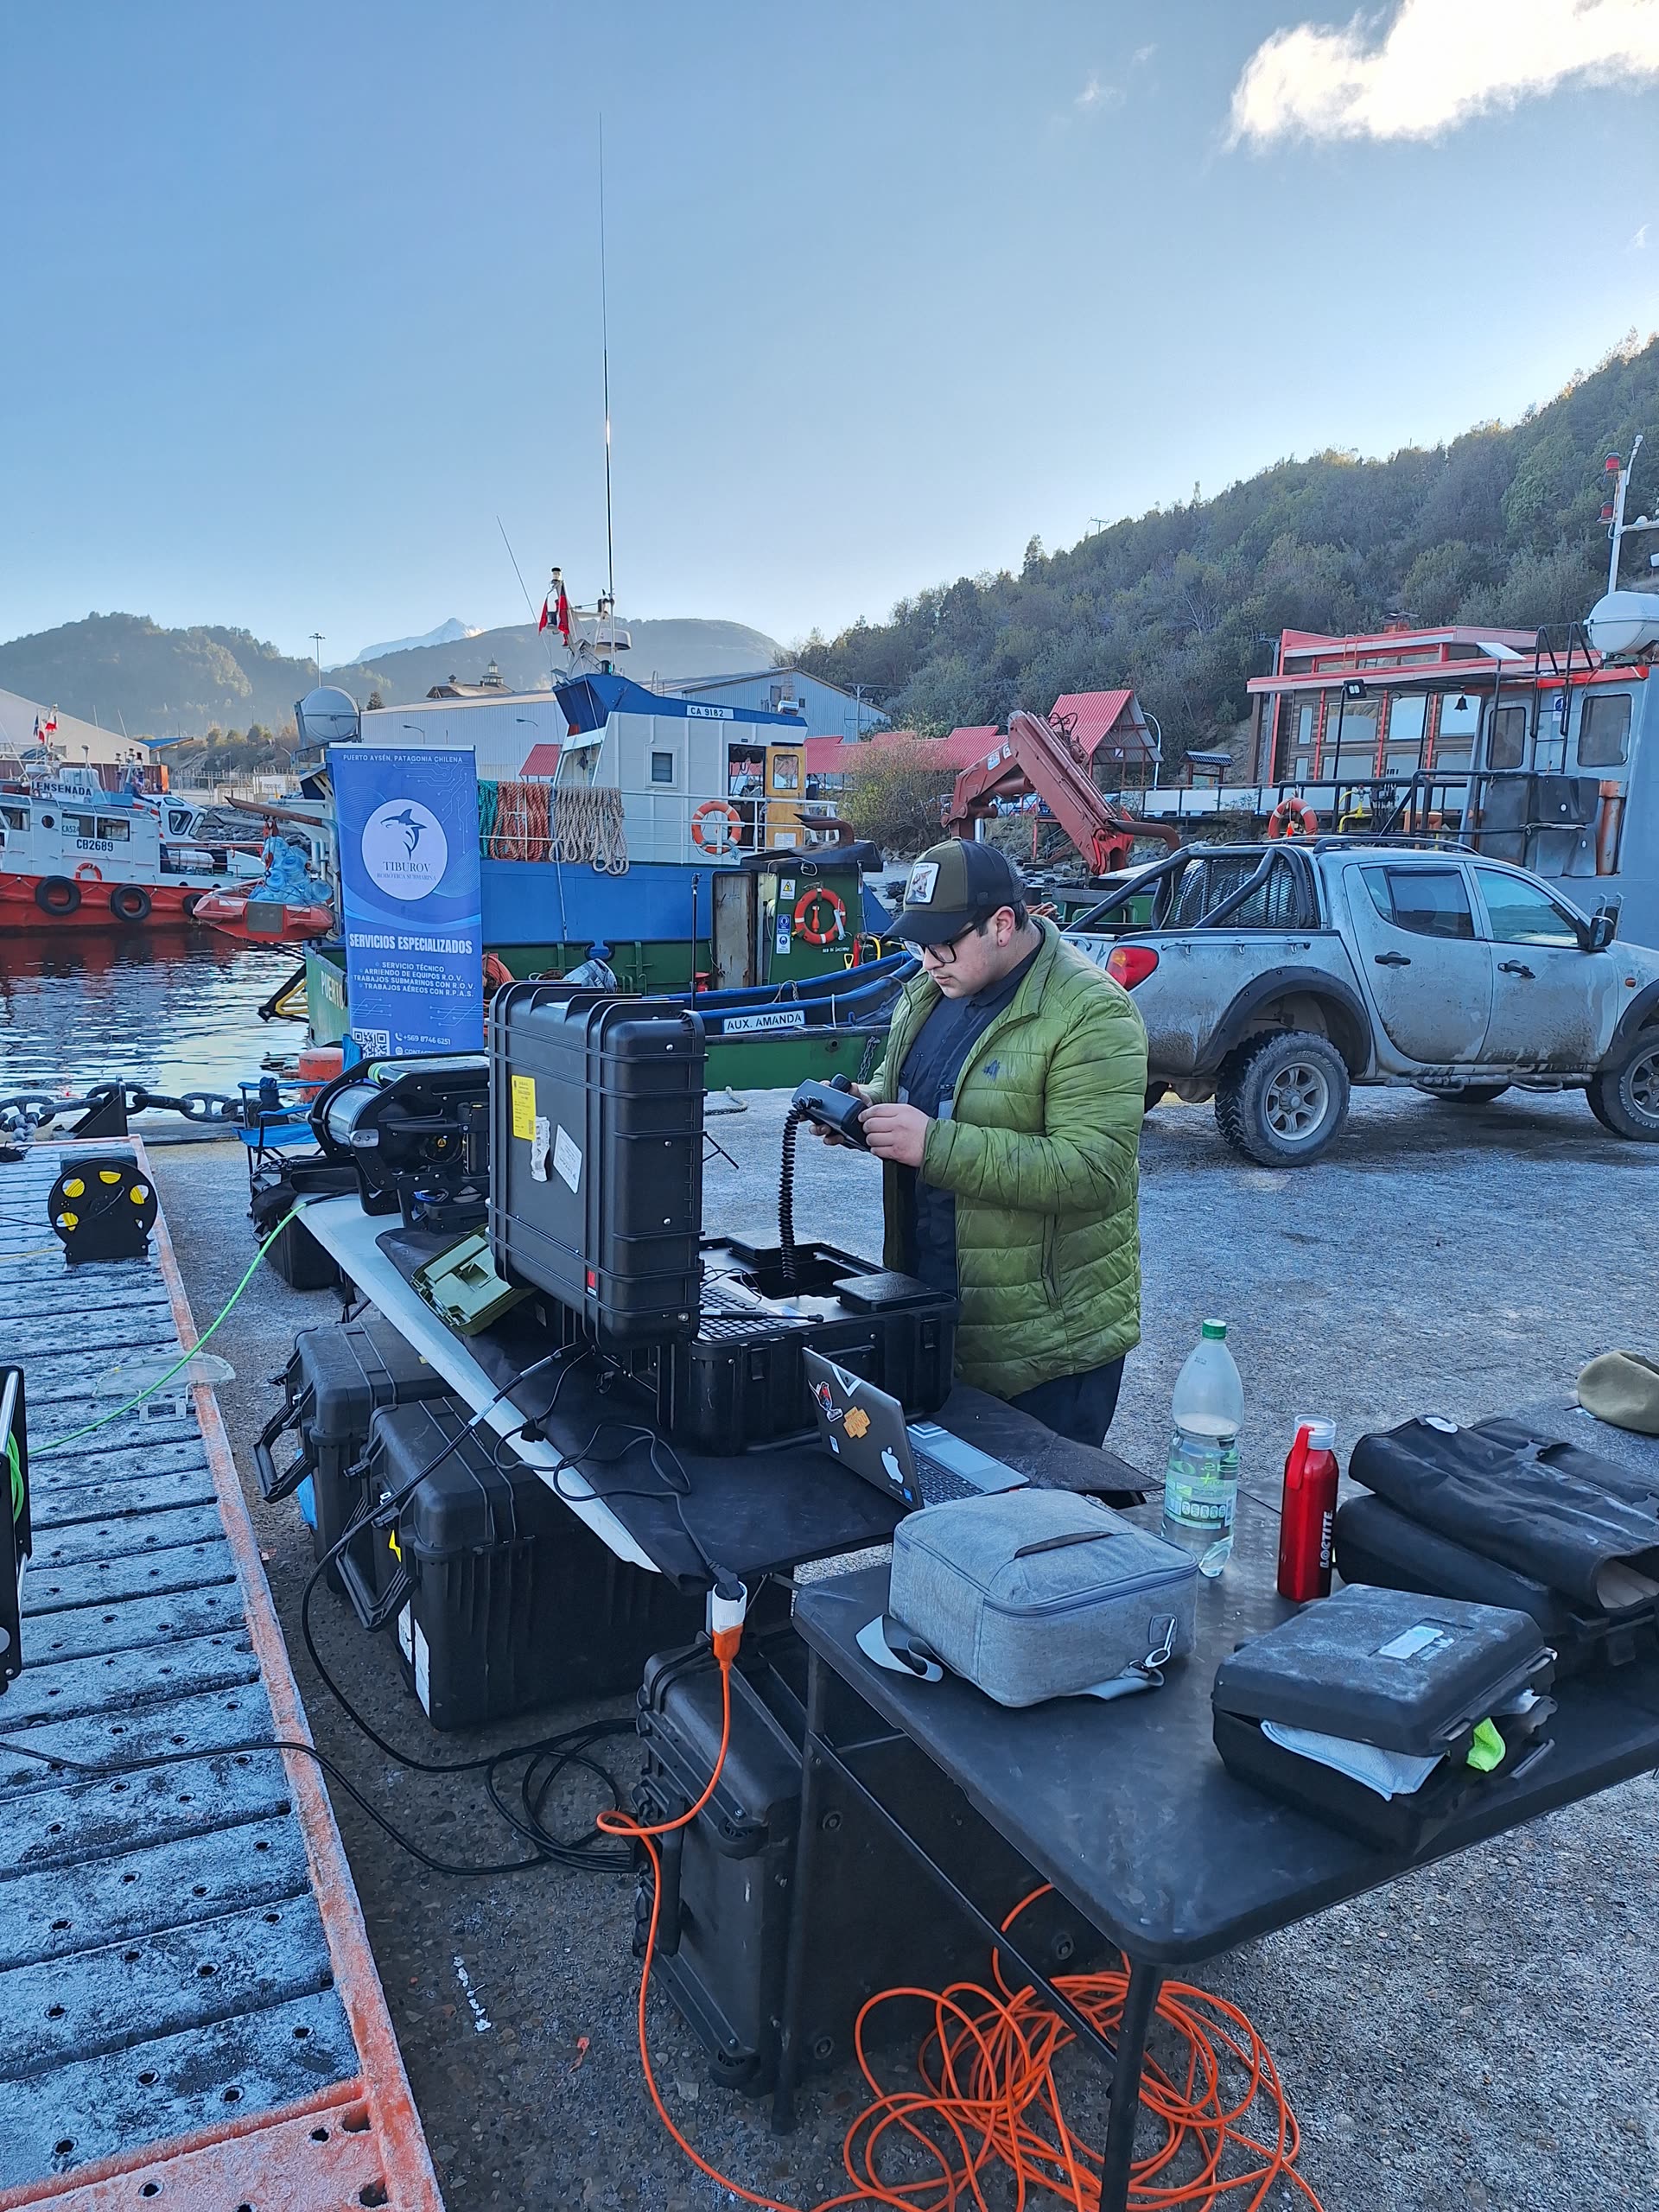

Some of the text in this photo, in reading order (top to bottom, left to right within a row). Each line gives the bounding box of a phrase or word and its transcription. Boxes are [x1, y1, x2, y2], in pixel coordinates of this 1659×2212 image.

[690, 707, 724, 717] CA 9182
[36, 781, 92, 797] ENSENADA
[76, 839, 114, 852] CB2689
[383, 861, 431, 872] TIBUROV
[349, 933, 473, 954] SERVICIOS ESPECIALIZADOS
[382, 962, 445, 973] SERVICIO TÉCNICO
[353, 974, 389, 983] TRABAJOS
[391, 977, 434, 987] SUBMARINOS
[364, 968, 400, 976] ARRIENDO
[412, 971, 441, 981] EQUIPOS
[321, 969, 344, 1010] PUERTO
[364, 982, 401, 991] TRABAJOS
[403, 984, 429, 994] AÉREOS
[727, 1013, 802, 1030] AUX. AMANDA
[420, 1035, 436, 1044] 8746
[1319, 1510, 1333, 1568] LOCTITE
